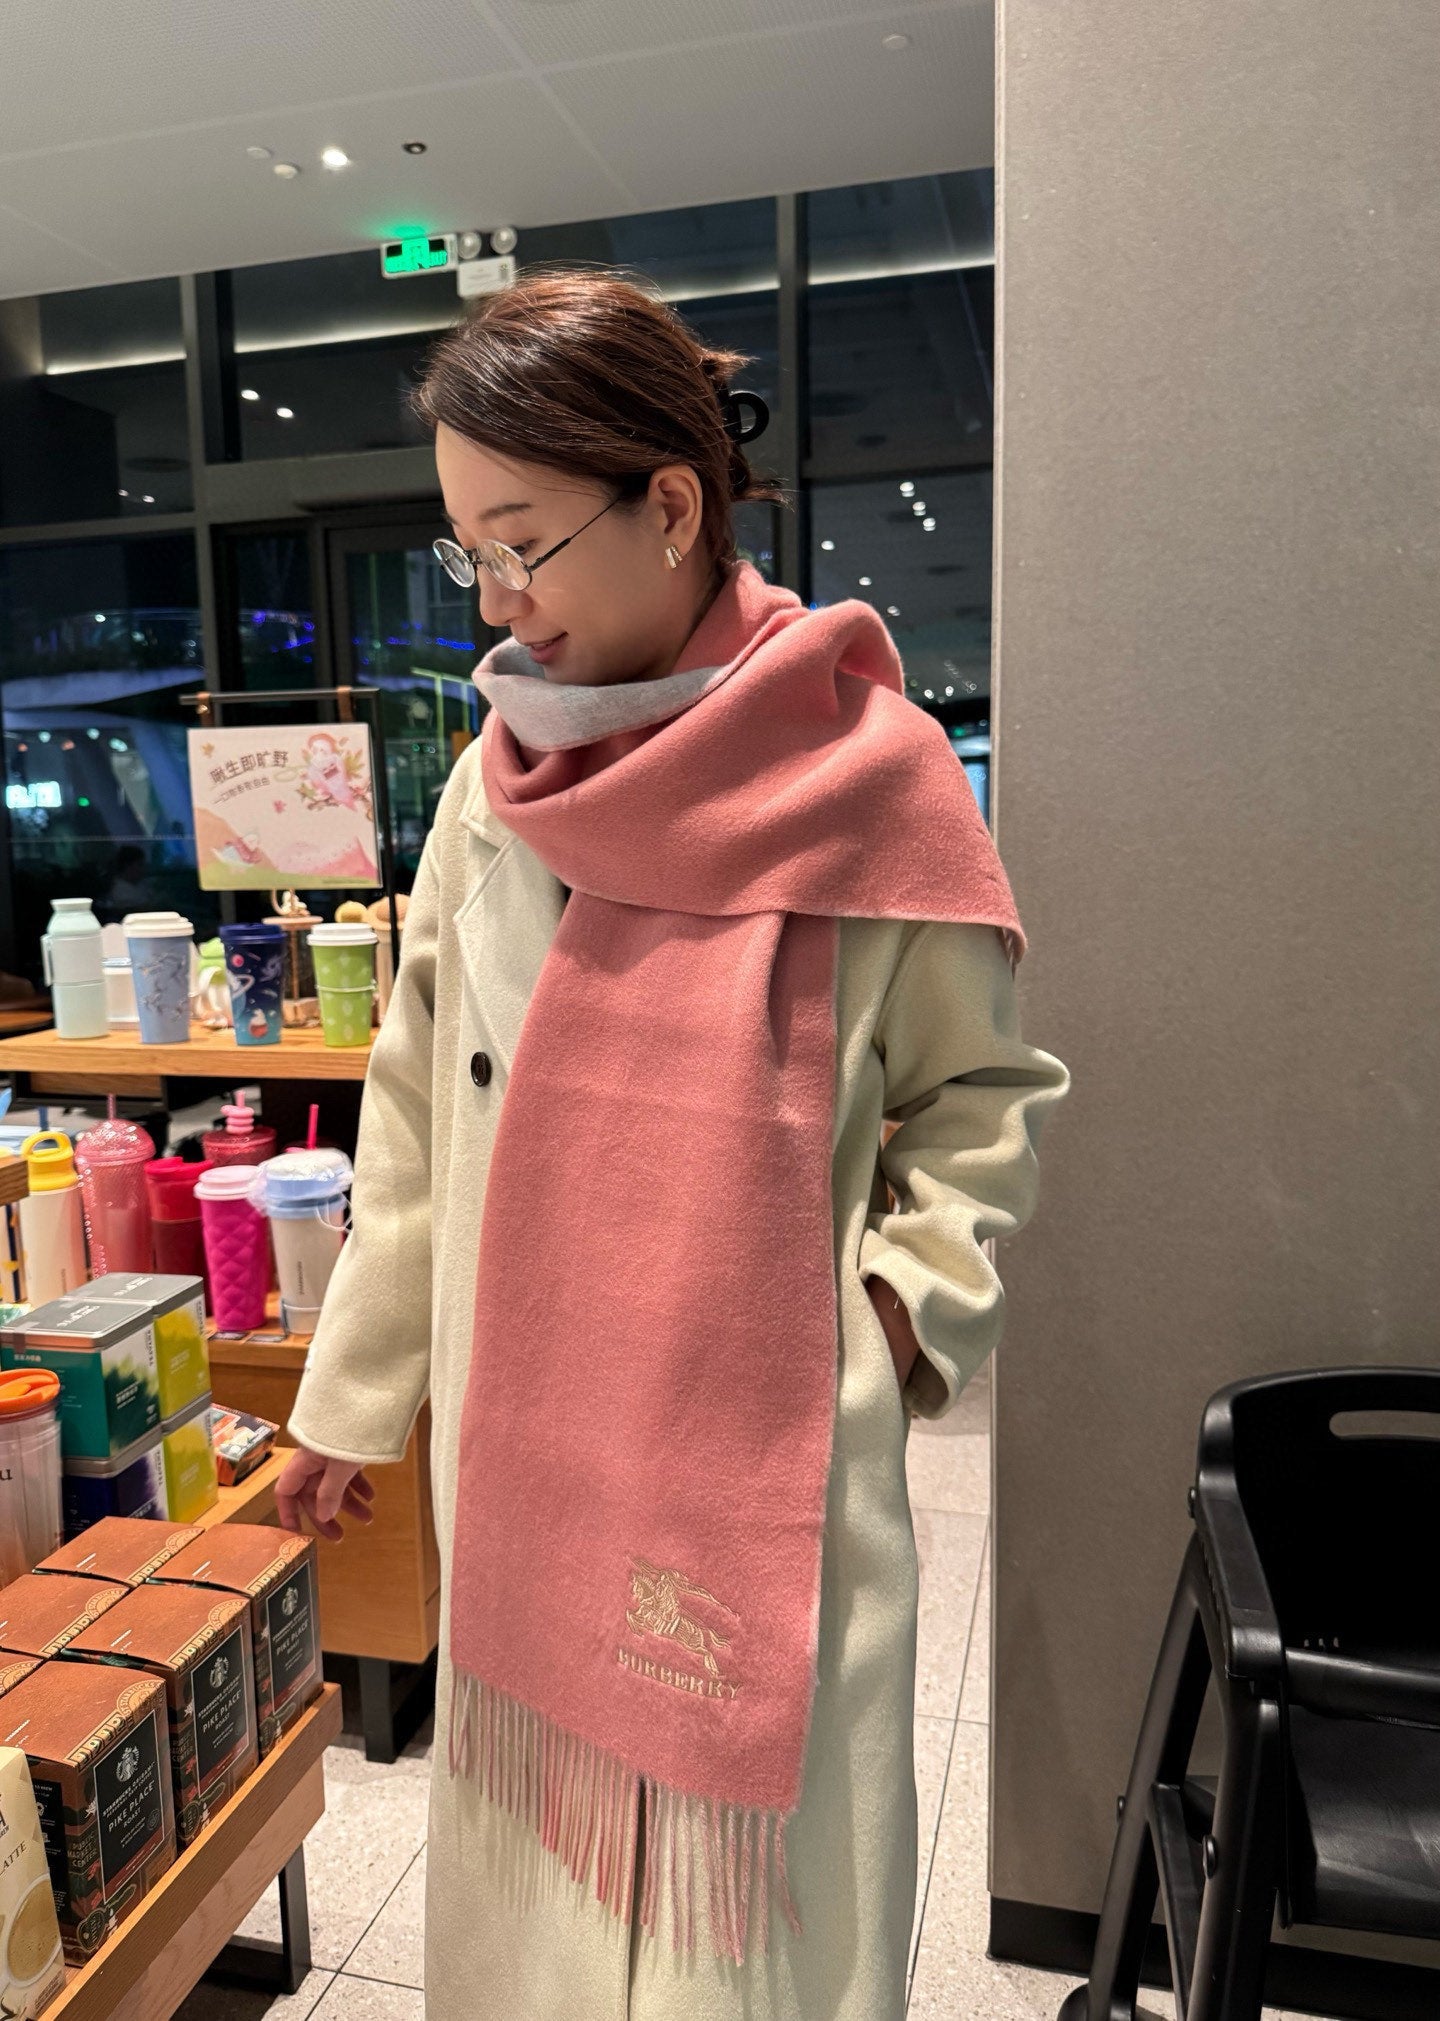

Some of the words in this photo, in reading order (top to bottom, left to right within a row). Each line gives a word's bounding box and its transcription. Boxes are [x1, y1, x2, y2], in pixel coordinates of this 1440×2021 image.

[617, 1648, 742, 1699] BURBERRY
[202, 1710, 218, 1734] PIKE
[108, 1806, 127, 1834] PIKE
[123, 1805, 140, 1829] ROAST
